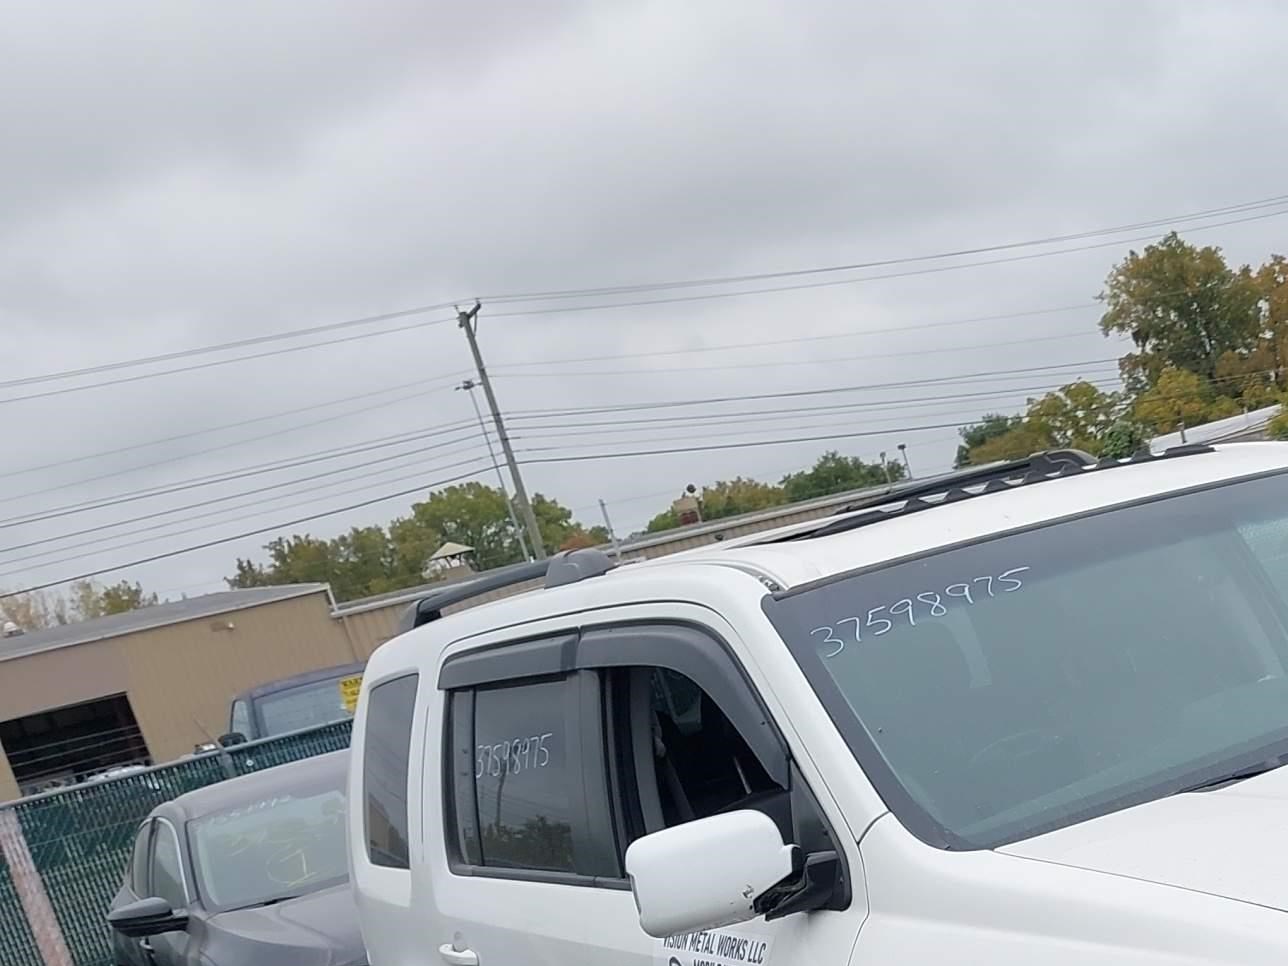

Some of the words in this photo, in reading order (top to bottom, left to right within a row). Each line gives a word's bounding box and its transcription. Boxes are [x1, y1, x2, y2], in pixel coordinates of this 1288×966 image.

[810, 566, 1030, 658] 37598975
[475, 733, 553, 778] 37598975
[689, 932, 716, 954] METAL
[717, 934, 748, 960] WORKS
[748, 941, 766, 964] LLC
